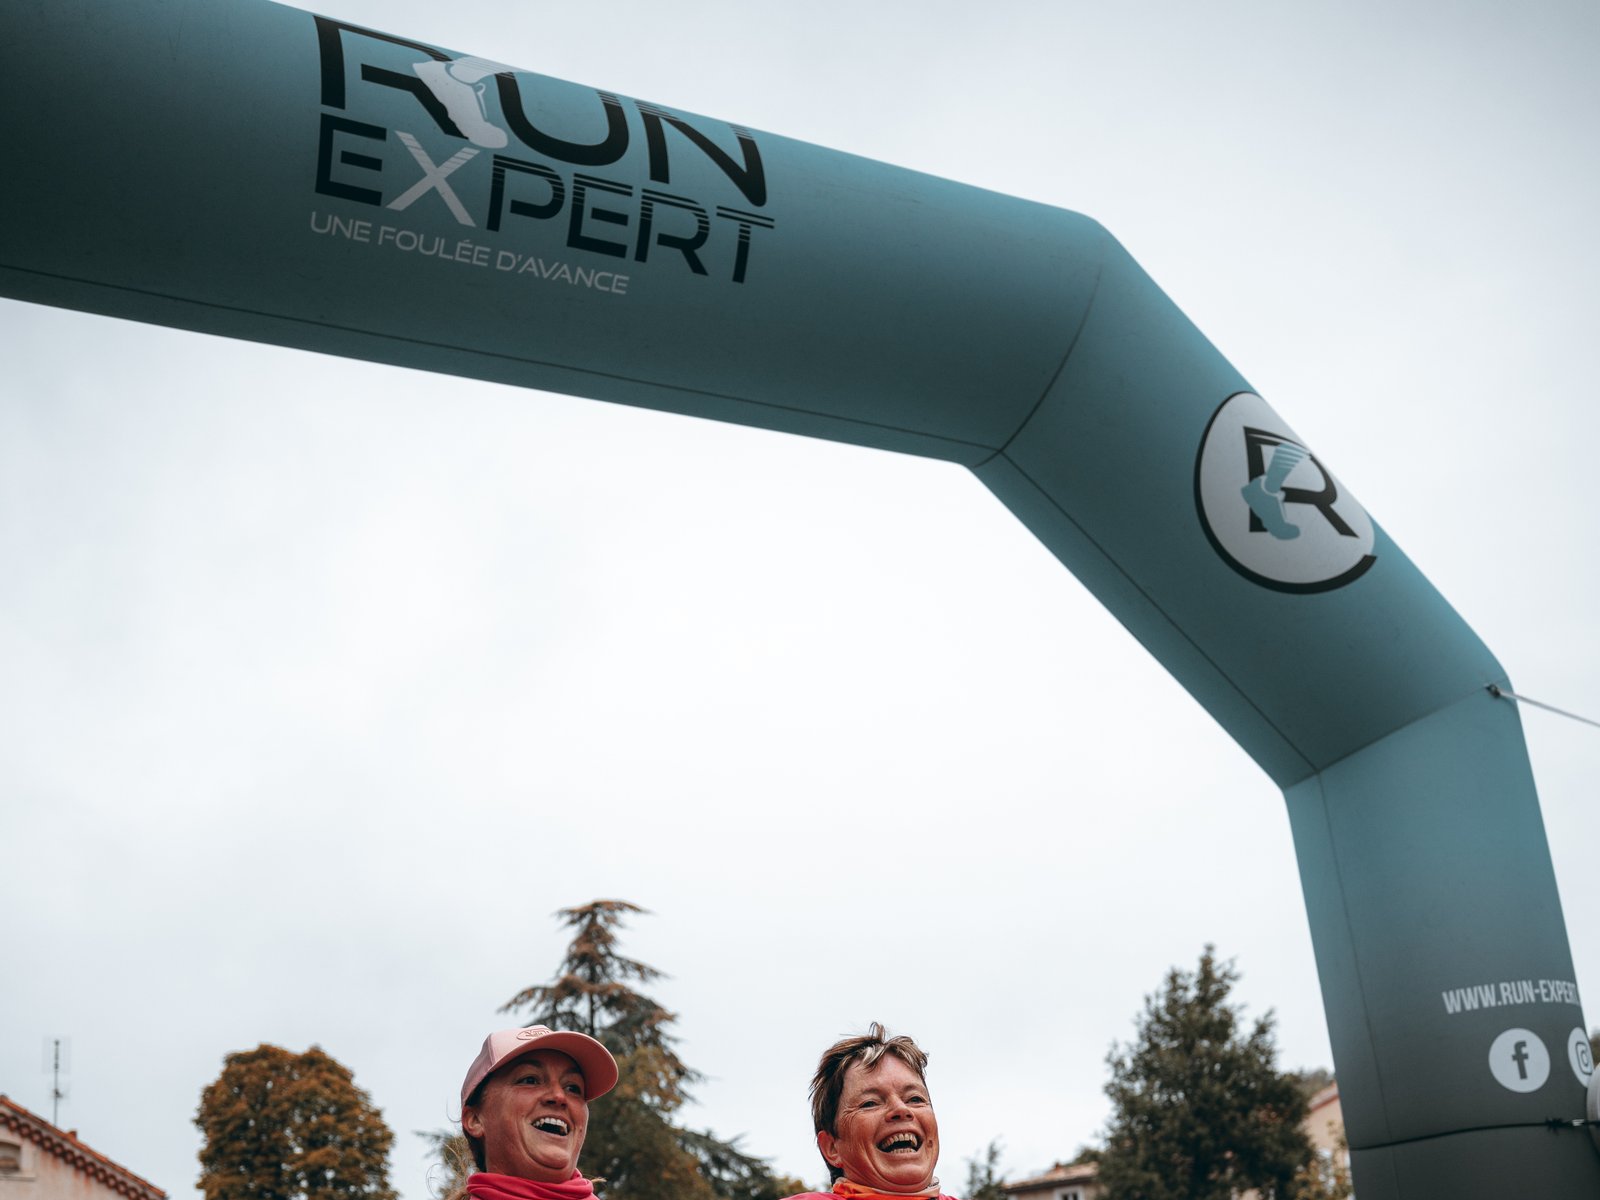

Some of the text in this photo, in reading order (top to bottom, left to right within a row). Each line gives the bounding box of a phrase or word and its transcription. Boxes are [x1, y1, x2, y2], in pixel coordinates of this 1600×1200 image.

[313, 15, 767, 208] RUN
[310, 211, 630, 295] UNE FOULÉE D'AVANCE
[315, 113, 775, 284] EXPERT
